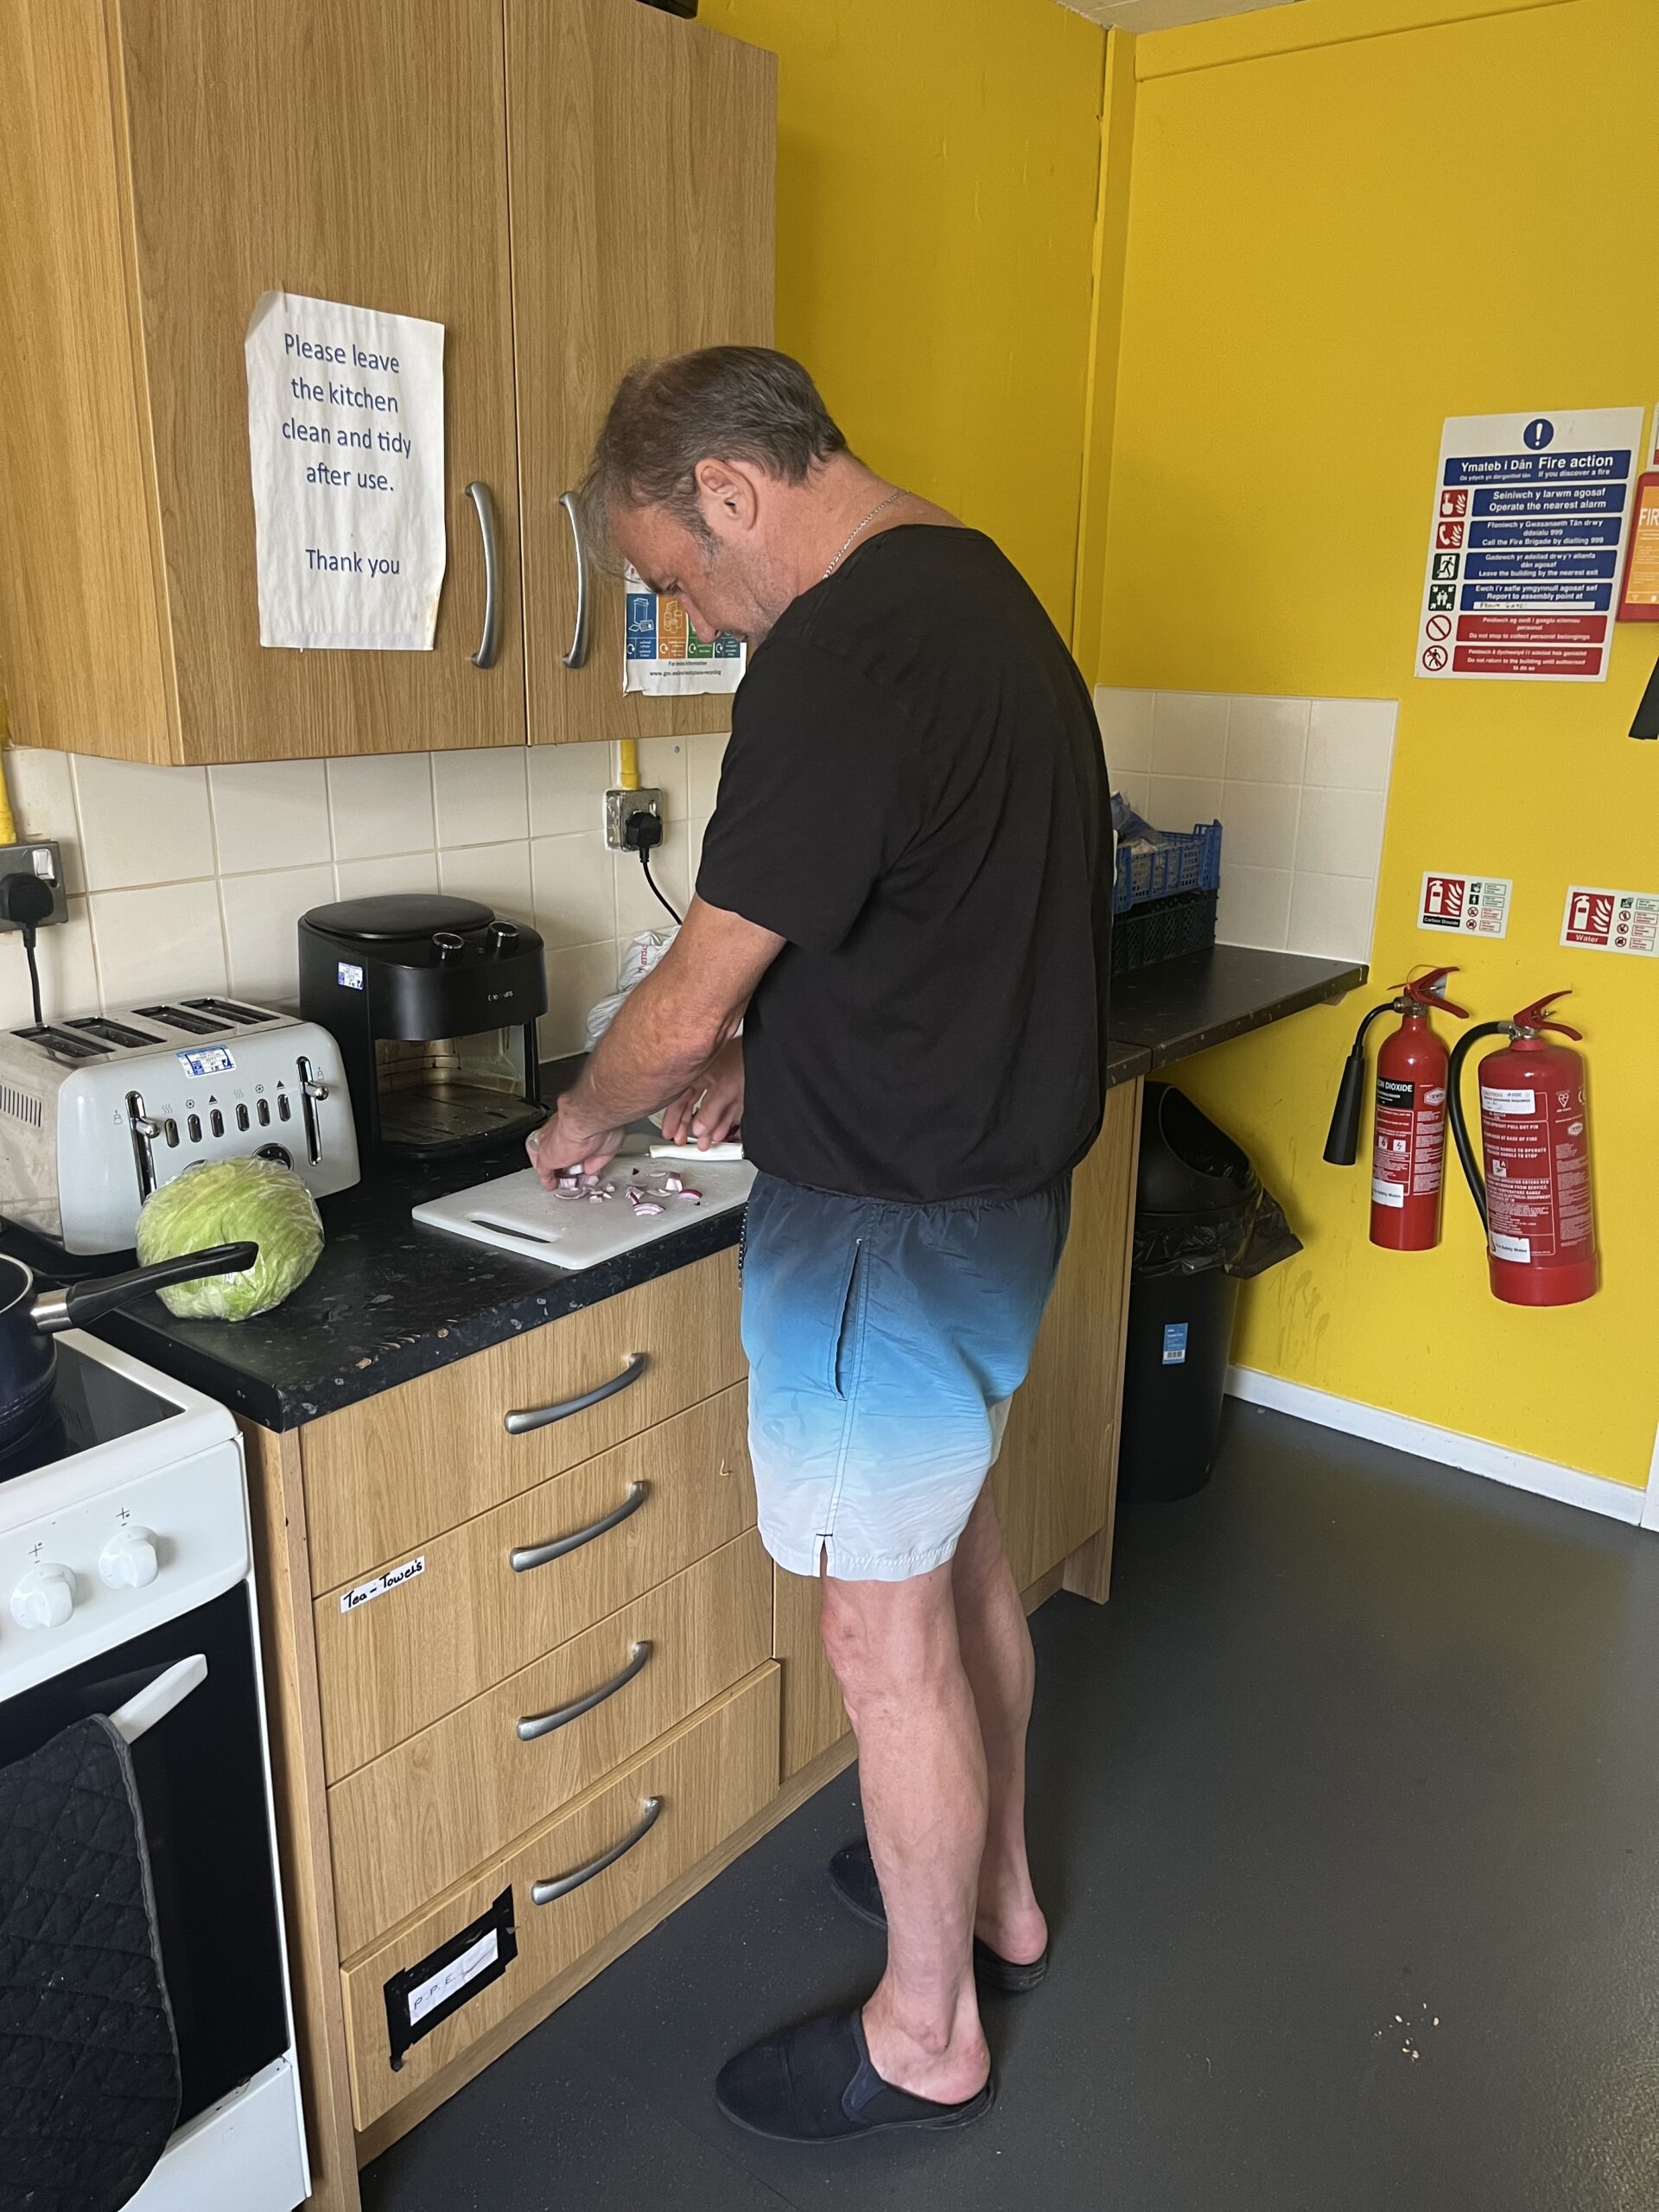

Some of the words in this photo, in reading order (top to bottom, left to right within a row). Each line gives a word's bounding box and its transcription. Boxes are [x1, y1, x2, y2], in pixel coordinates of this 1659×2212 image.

[284, 334, 346, 364] Please
[353, 344, 399, 373] leave
[291, 378, 324, 401] the
[329, 381, 397, 412] kitchen
[283, 418, 331, 444] clean
[337, 428, 372, 449] and
[378, 431, 411, 459] tidy
[1461, 462, 1501, 472] Ymateb
[1510, 459, 1532, 470] Dân
[1538, 456, 1566, 469] Fire
[1570, 454, 1613, 467] action
[306, 461, 351, 486] after
[358, 472, 394, 491] use.
[1535, 492, 1541, 500] y
[1573, 487, 1606, 499] agosaf
[1489, 502, 1524, 512] Operate
[1527, 501, 1541, 511] the
[1543, 500, 1578, 510] nearest
[1580, 499, 1606, 508] alarm
[305, 549, 363, 573] Thank
[368, 556, 399, 578] you
[1576, 933, 1599, 943] Water
[1385, 1082, 1413, 1092] DIOXIDE
